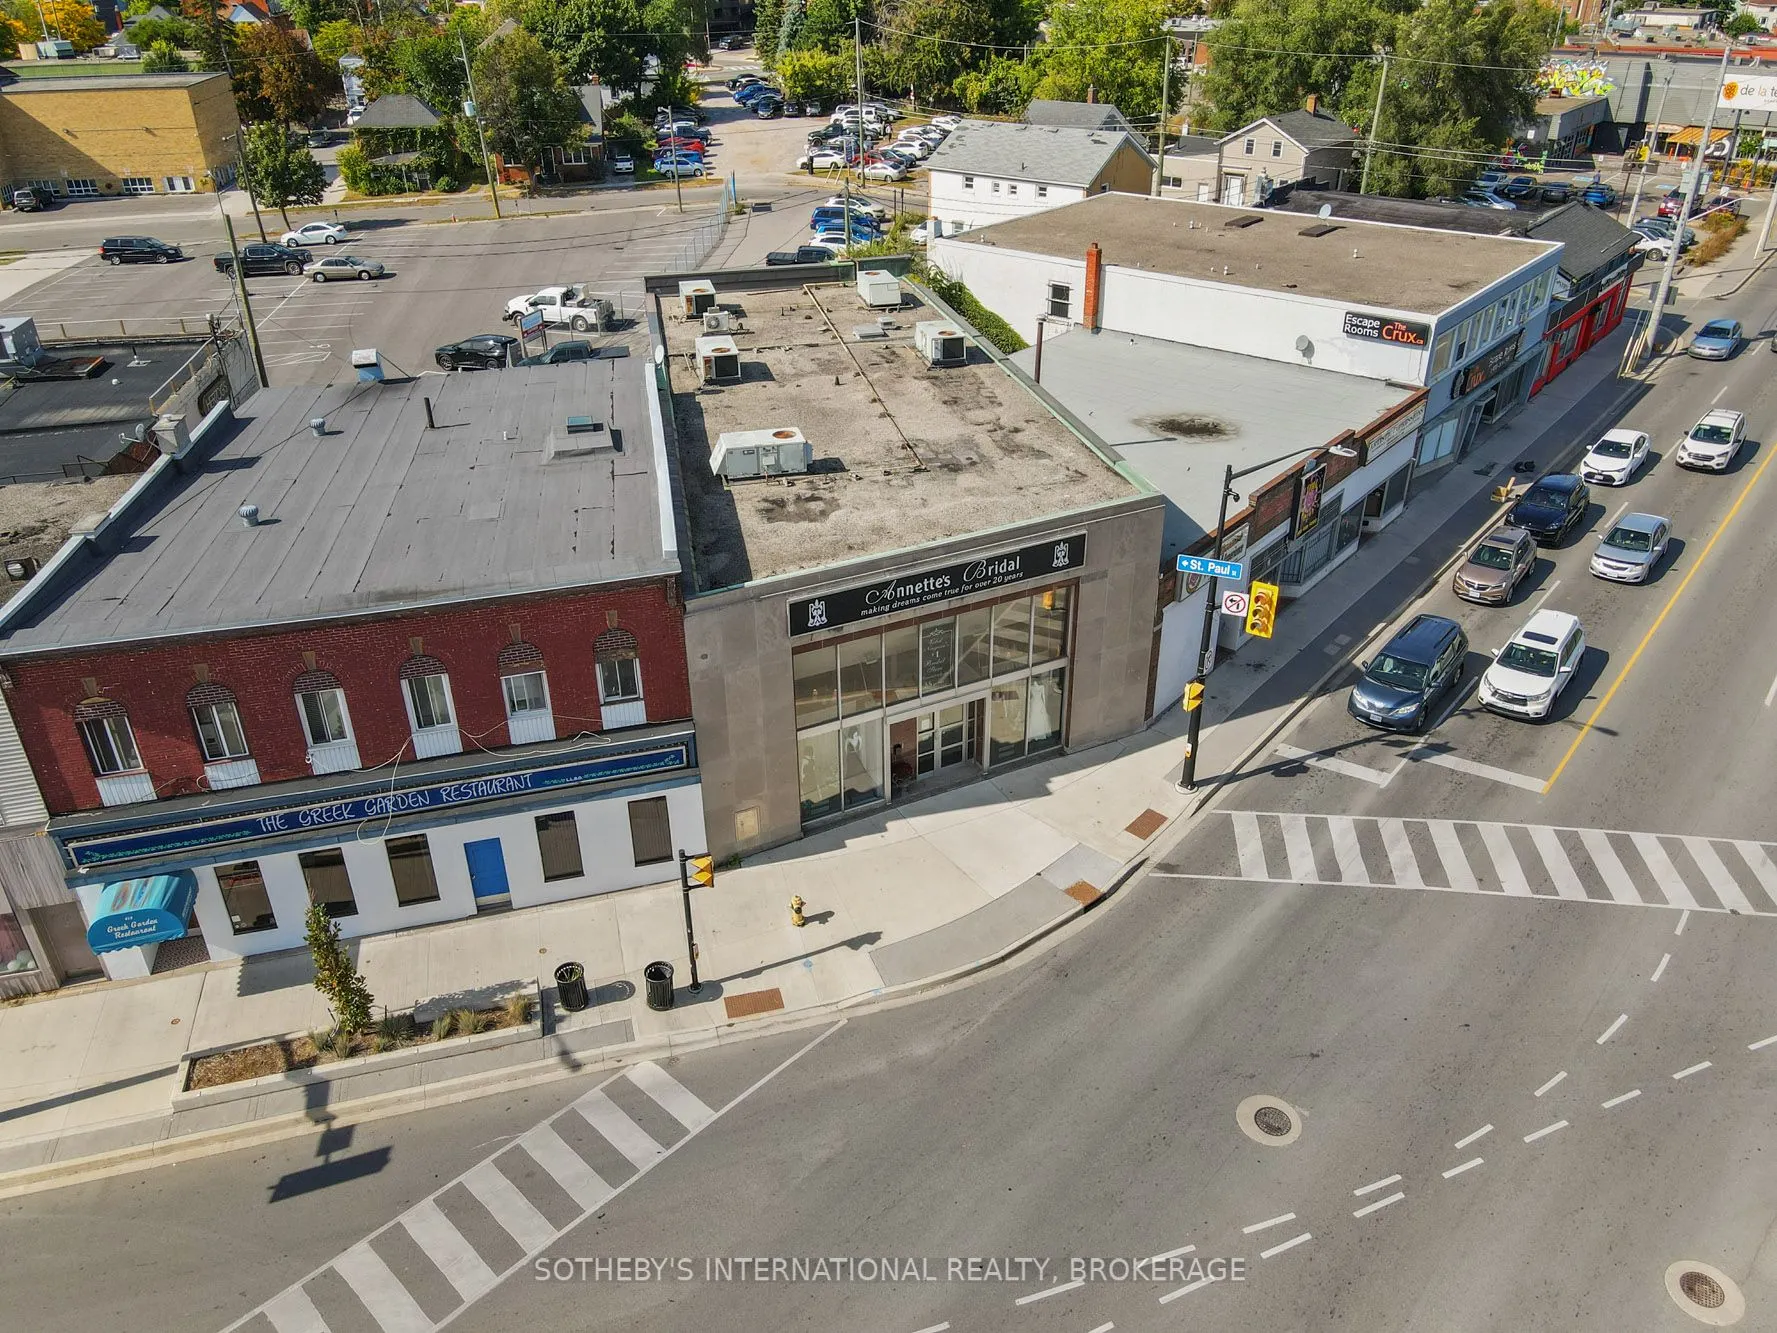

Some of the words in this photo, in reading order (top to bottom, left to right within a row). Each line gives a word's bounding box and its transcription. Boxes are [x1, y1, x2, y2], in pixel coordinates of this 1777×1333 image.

[1740, 84, 1755, 96] de
[1345, 314, 1380, 328] Escape
[1393, 321, 1407, 331] The
[1344, 324, 1379, 338] Rooms
[1189, 559, 1204, 571] St.
[1208, 562, 1231, 575] Paul
[865, 574, 951, 605] Annette's
[963, 556, 1021, 581] Bridal
[861, 603, 890, 616] making
[892, 597, 920, 609] dreams
[922, 591, 943, 602] come
[944, 586, 960, 598] true
[961, 582, 973, 594] for
[974, 581, 991, 590] over
[992, 576, 1003, 585] 20
[1003, 571, 1024, 583] years
[256, 816, 288, 834] THE
[299, 803, 355, 827] GREEK
[365, 790, 430, 815] GARDEN
[440, 773, 534, 802] RESTAURANT
[108, 924, 128, 933] Greek
[131, 919, 158, 928] Garden
[115, 925, 157, 938] Restaurant
